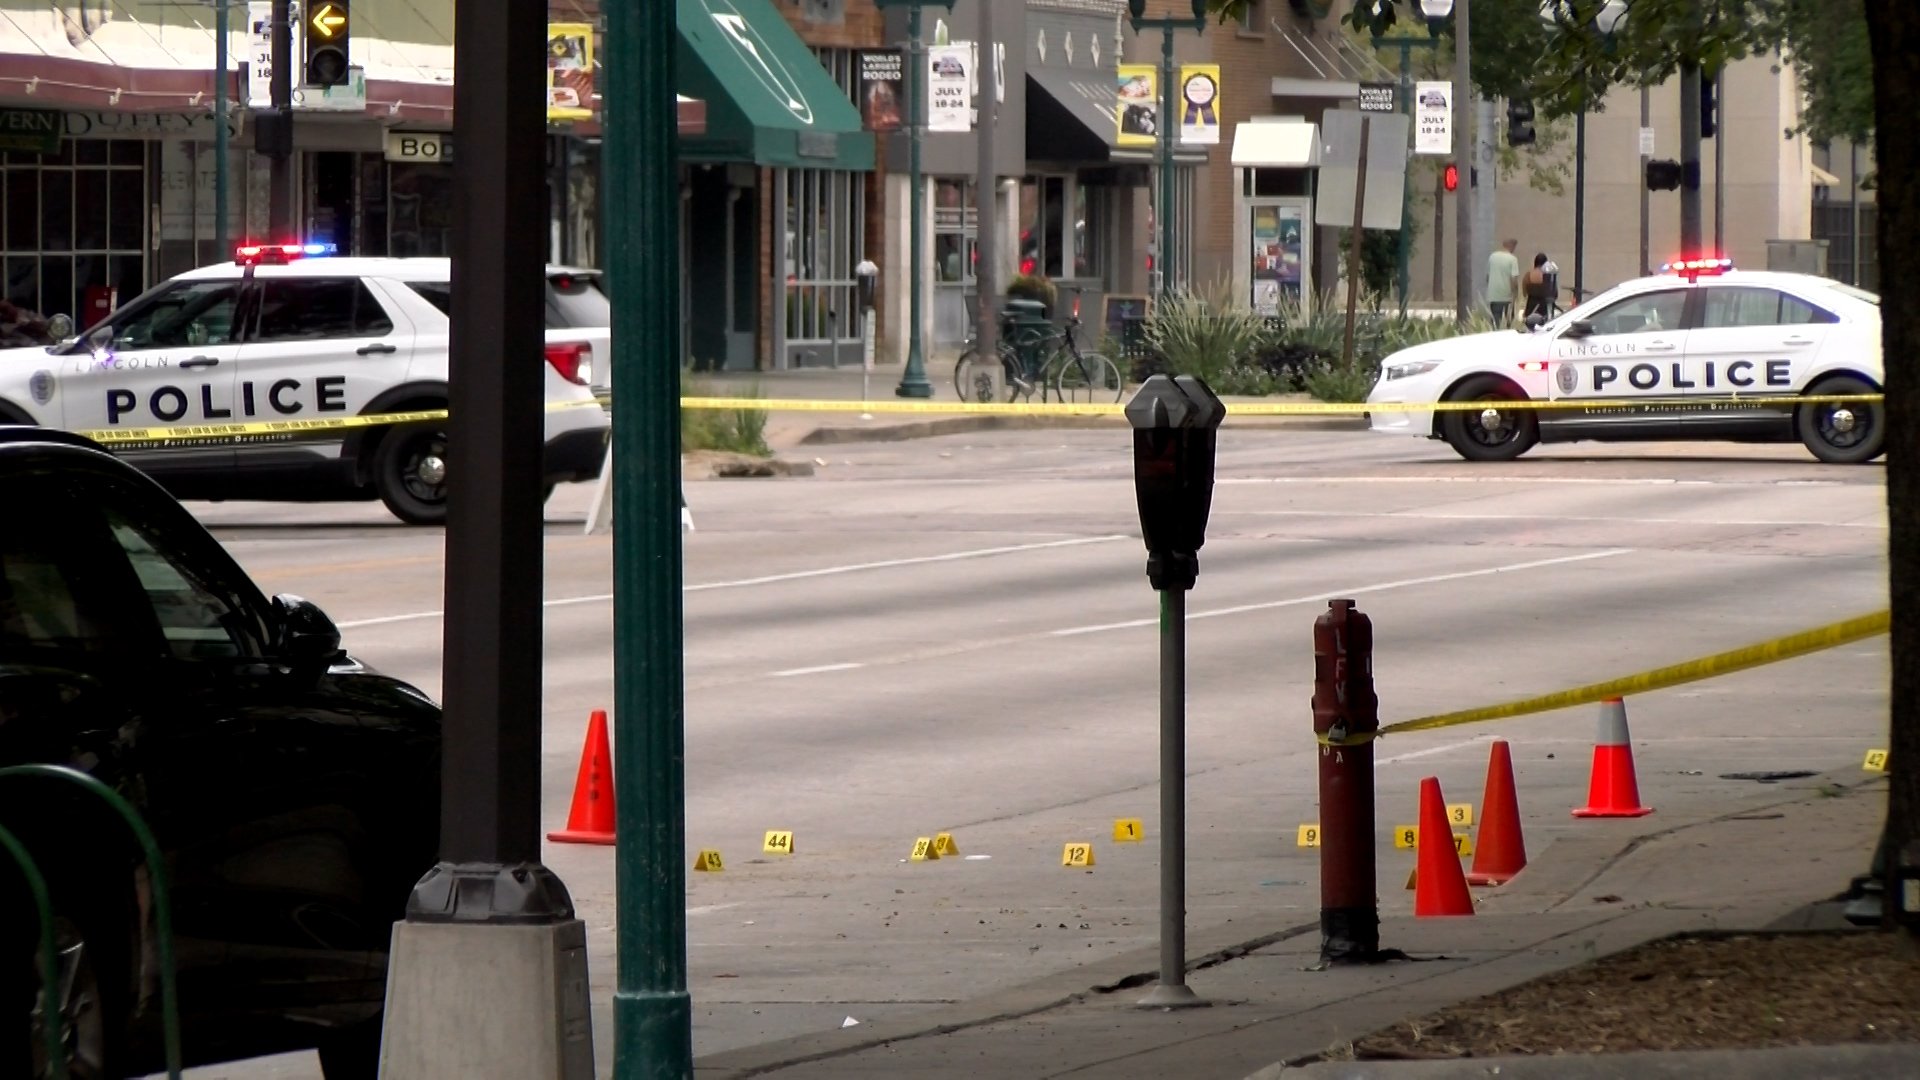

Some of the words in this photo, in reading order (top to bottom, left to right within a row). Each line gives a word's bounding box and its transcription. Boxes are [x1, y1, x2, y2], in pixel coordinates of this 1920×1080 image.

[863, 71, 901, 80] RODEO
[935, 88, 963, 96] JULY
[1558, 344, 1636, 358] LINCOLN
[75, 356, 169, 372] LINCOLN
[1593, 360, 1791, 390] POLICE
[107, 375, 346, 424] POLICE
[104, 441, 159, 450] eadership
[1867, 753, 1884, 767] 42
[1454, 807, 1464, 822] 3
[1126, 823, 1134, 837] 1
[1306, 828, 1316, 842] 9
[1405, 829, 1414, 844] 8
[768, 834, 787, 849] 44
[708, 853, 722, 868] 43
[1068, 847, 1085, 862] 12
